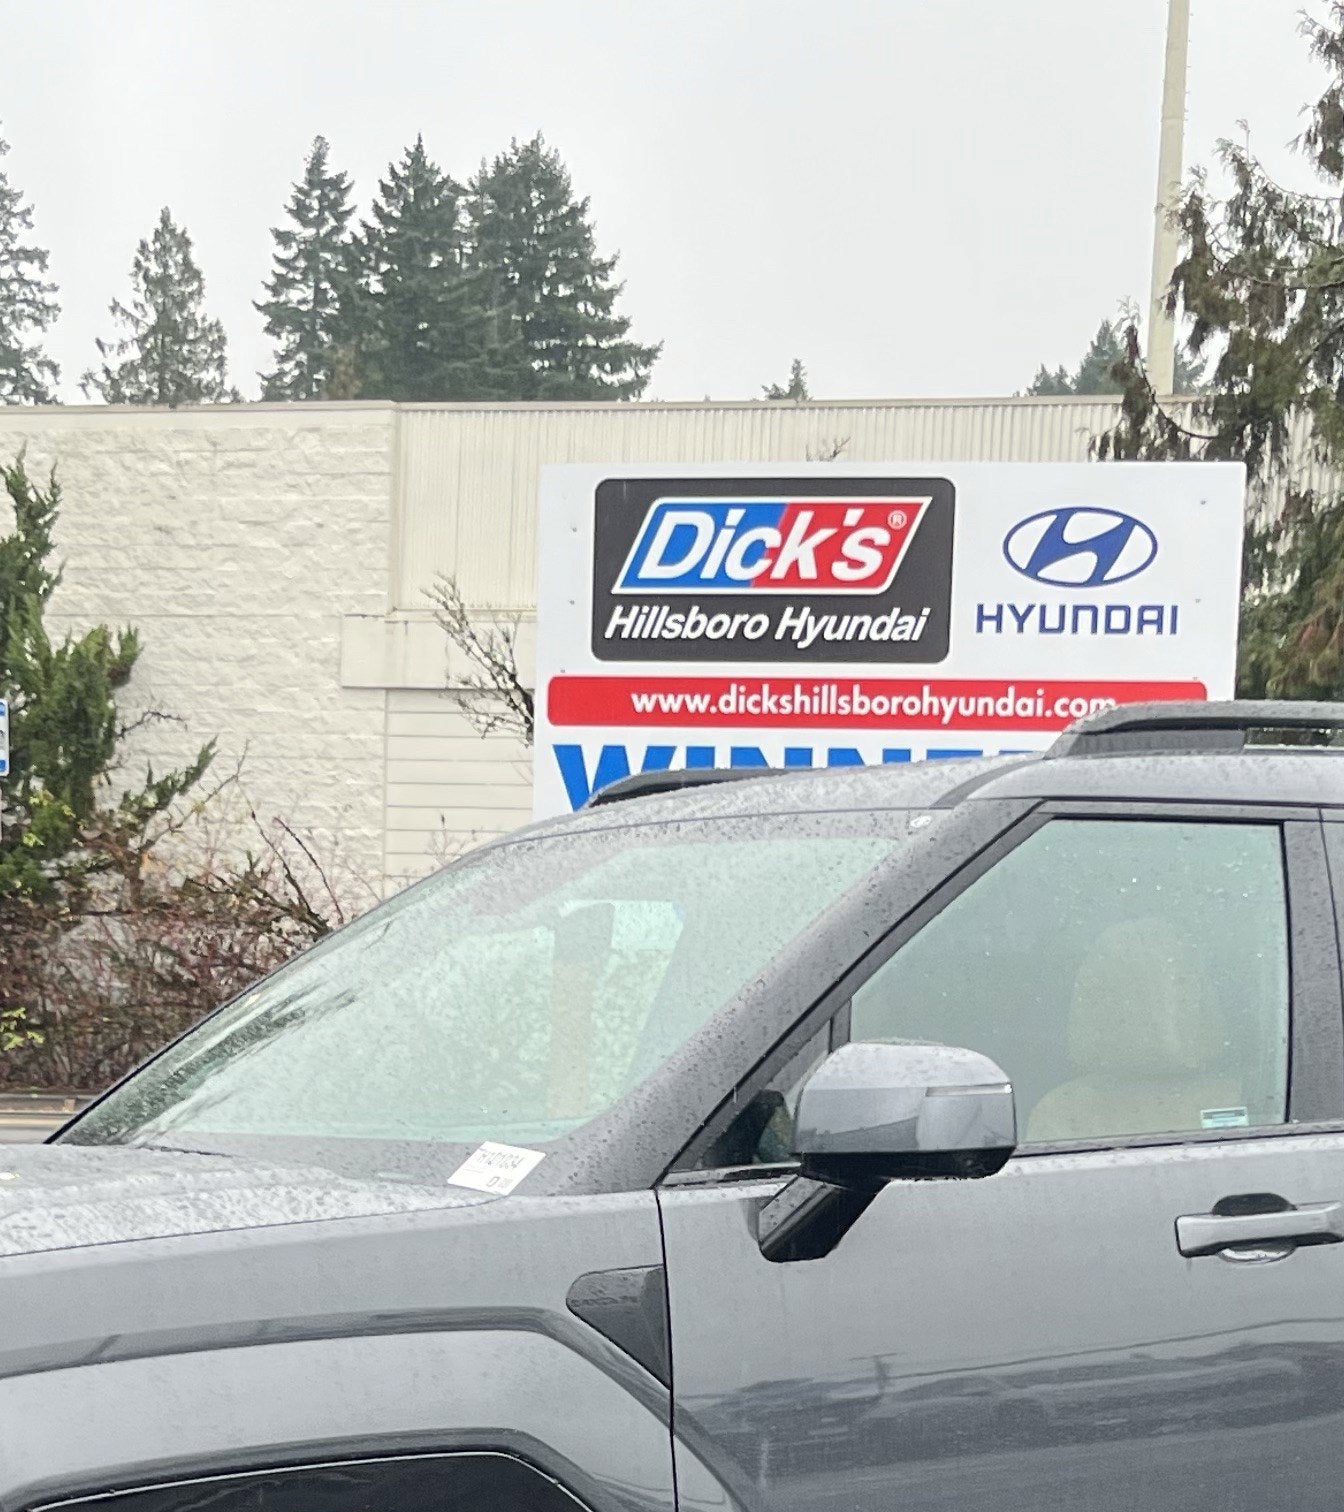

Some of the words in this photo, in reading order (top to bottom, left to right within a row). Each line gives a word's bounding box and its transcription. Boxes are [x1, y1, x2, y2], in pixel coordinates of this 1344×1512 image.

[605, 604, 770, 640] Hillsboro
[775, 606, 932, 649] Hyundai
[976, 603, 1178, 636] HYUNDAI
[630, 684, 1116, 725] www.dickshillsborohyundai.com
